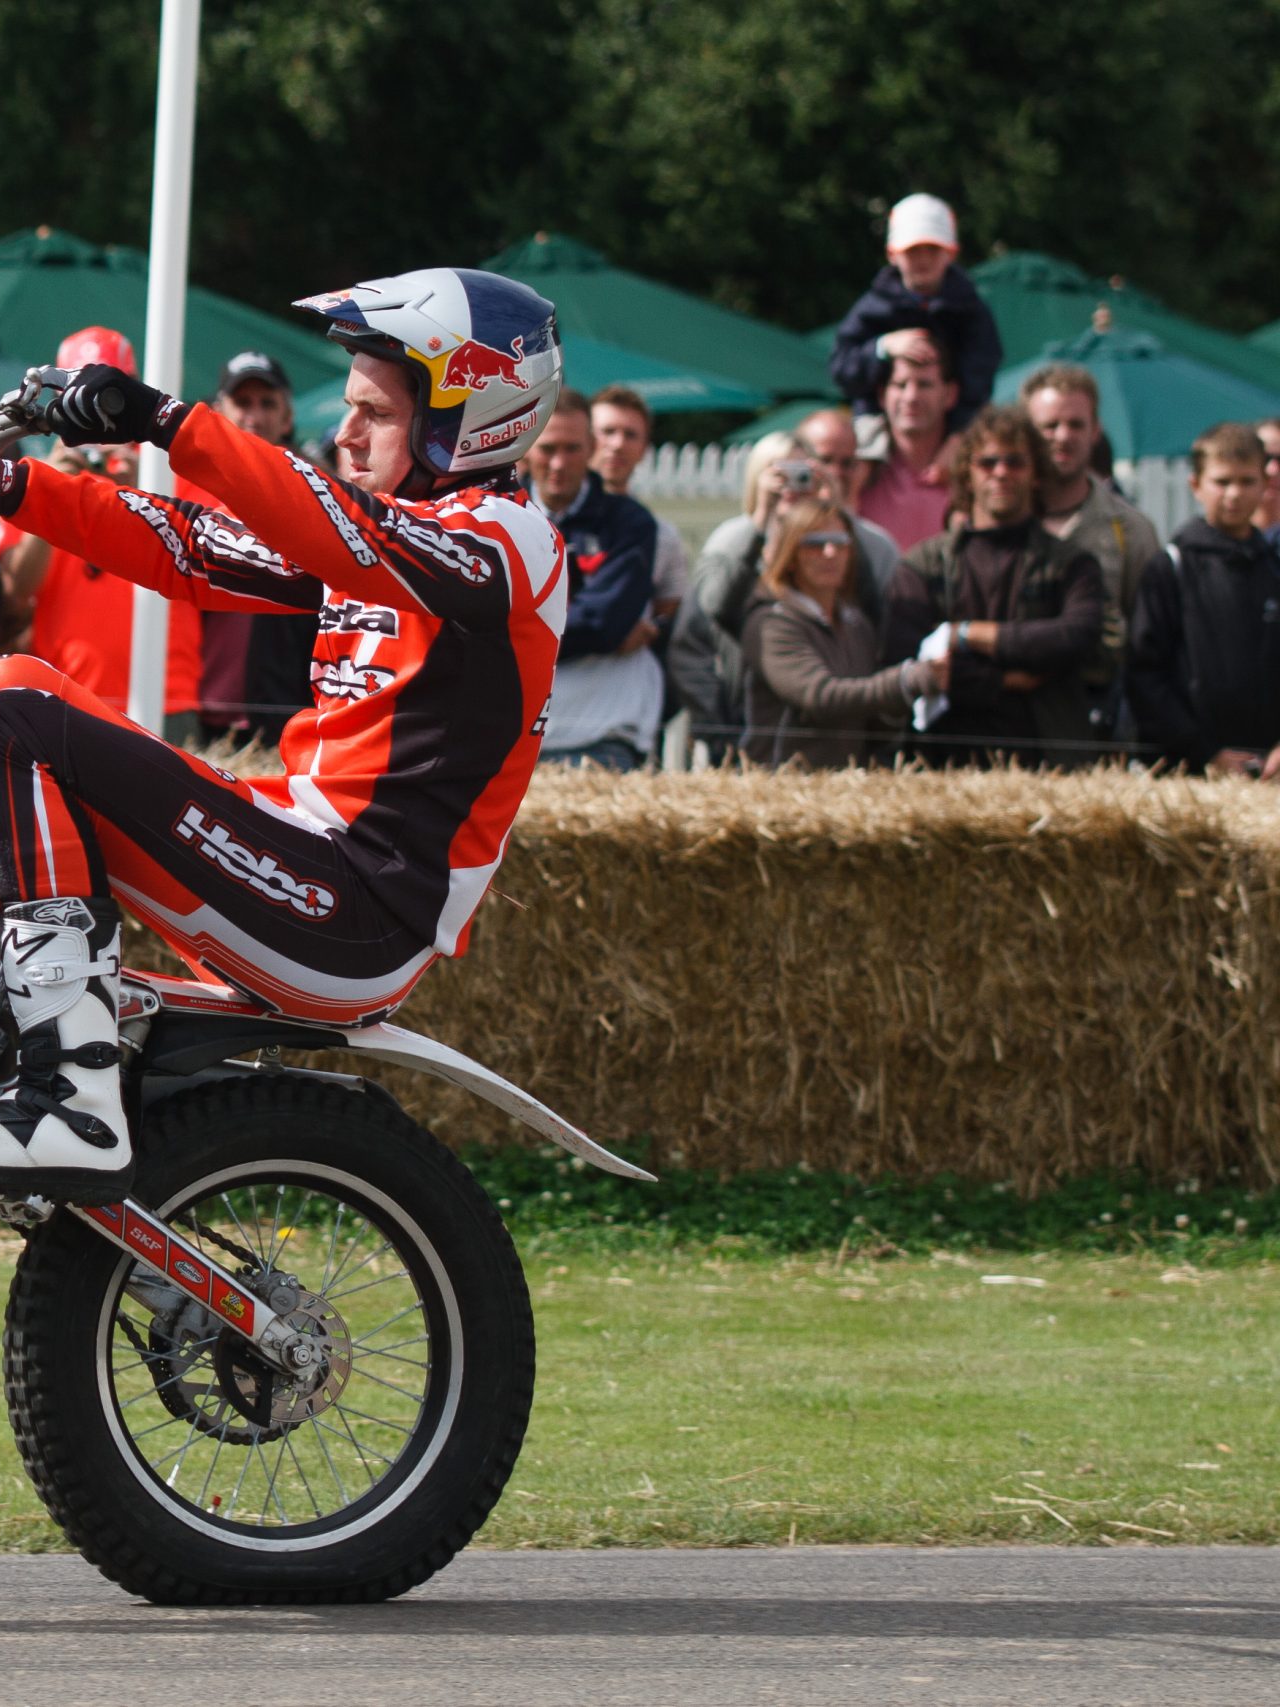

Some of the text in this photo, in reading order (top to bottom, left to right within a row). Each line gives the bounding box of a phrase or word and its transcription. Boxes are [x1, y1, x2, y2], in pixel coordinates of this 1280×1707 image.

[480, 411, 537, 448] Red Bull
[319, 600, 398, 638] eta
[176, 805, 335, 917] Hebo
[129, 1227, 162, 1251] SKF
